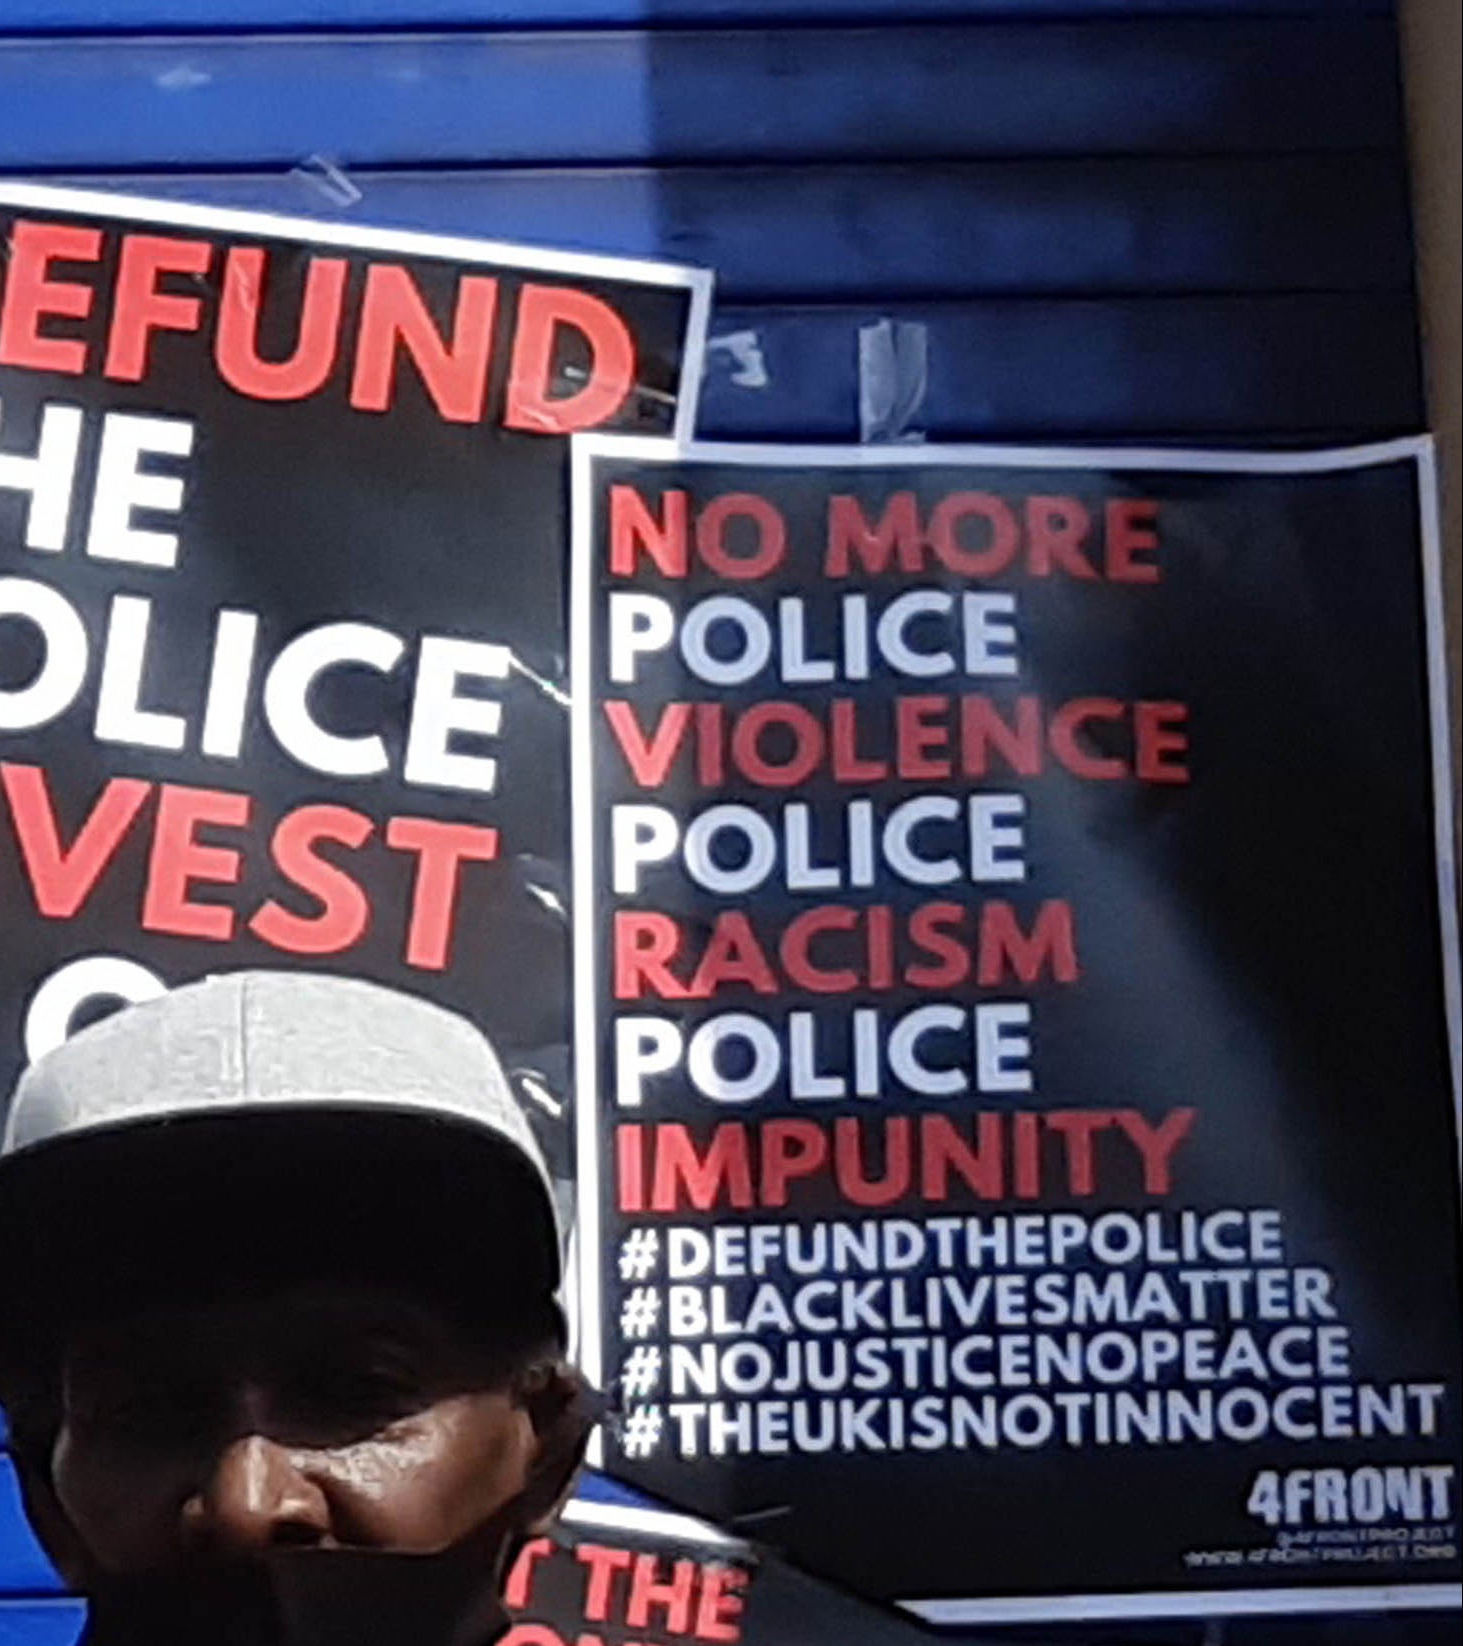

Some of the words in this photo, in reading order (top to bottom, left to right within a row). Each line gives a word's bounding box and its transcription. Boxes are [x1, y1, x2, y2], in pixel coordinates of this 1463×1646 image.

[609, 485, 785, 578] NO
[828, 497, 1155, 580] MORE
[609, 592, 1017, 684] POLICE
[606, 699, 1185, 787] VIOLENCE
[611, 795, 1024, 896] POLICE
[613, 905, 1077, 1000] RACISM
[615, 1004, 1031, 1108] POLICE
[616, 1113, 1190, 1214] IMPUNITY
[619, 1211, 1283, 1279] #DEFUNDTHEPOLICE
[619, 1268, 1338, 1337] #BLACKLIVESMATTER
[620, 1326, 1351, 1395] #NOJUSTICENOPEACE
[620, 1384, 1445, 1456] #THEUKISNOTINNOCENT
[1249, 1468, 1452, 1523] 4FRONT
[575, 1545, 747, 1642] THE
